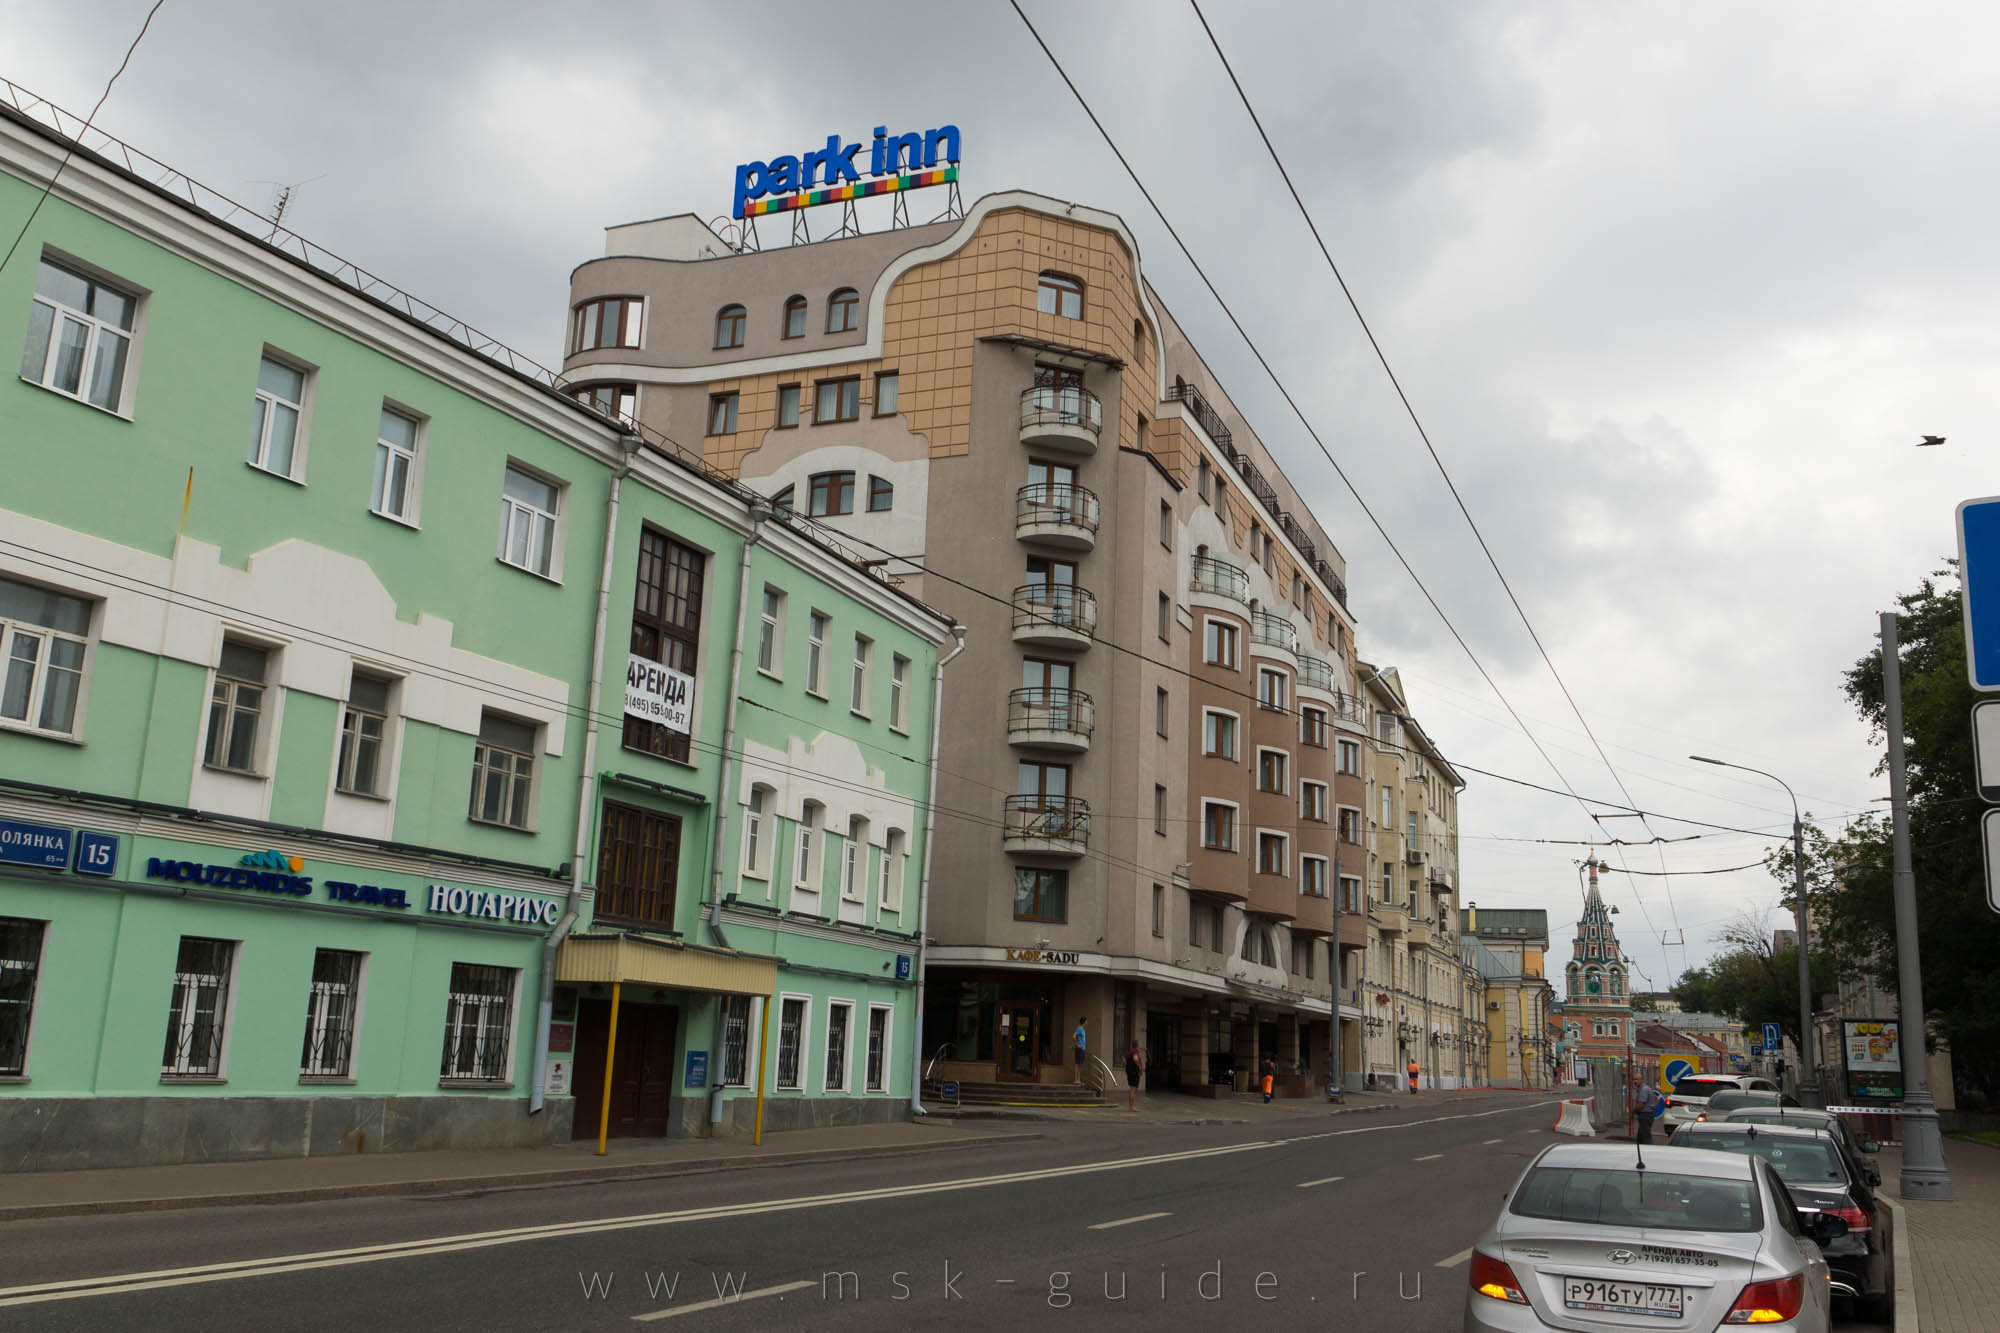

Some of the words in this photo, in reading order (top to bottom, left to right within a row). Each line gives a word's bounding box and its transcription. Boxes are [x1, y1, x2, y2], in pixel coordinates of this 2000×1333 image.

[733, 135, 862, 220] park
[871, 125, 960, 177] inn
[627, 661, 686, 706] АРЕНДА
[88, 844, 111, 865] 15
[146, 857, 313, 896] MOUZENIDIS
[325, 880, 411, 909] TRAVEL
[429, 885, 559, 926] НОТАРИУС
[1641, 1245, 1678, 1256] АРЕНДА
[1680, 1250, 1704, 1258] АВТО
[1652, 1255, 1674, 1264] (929)
